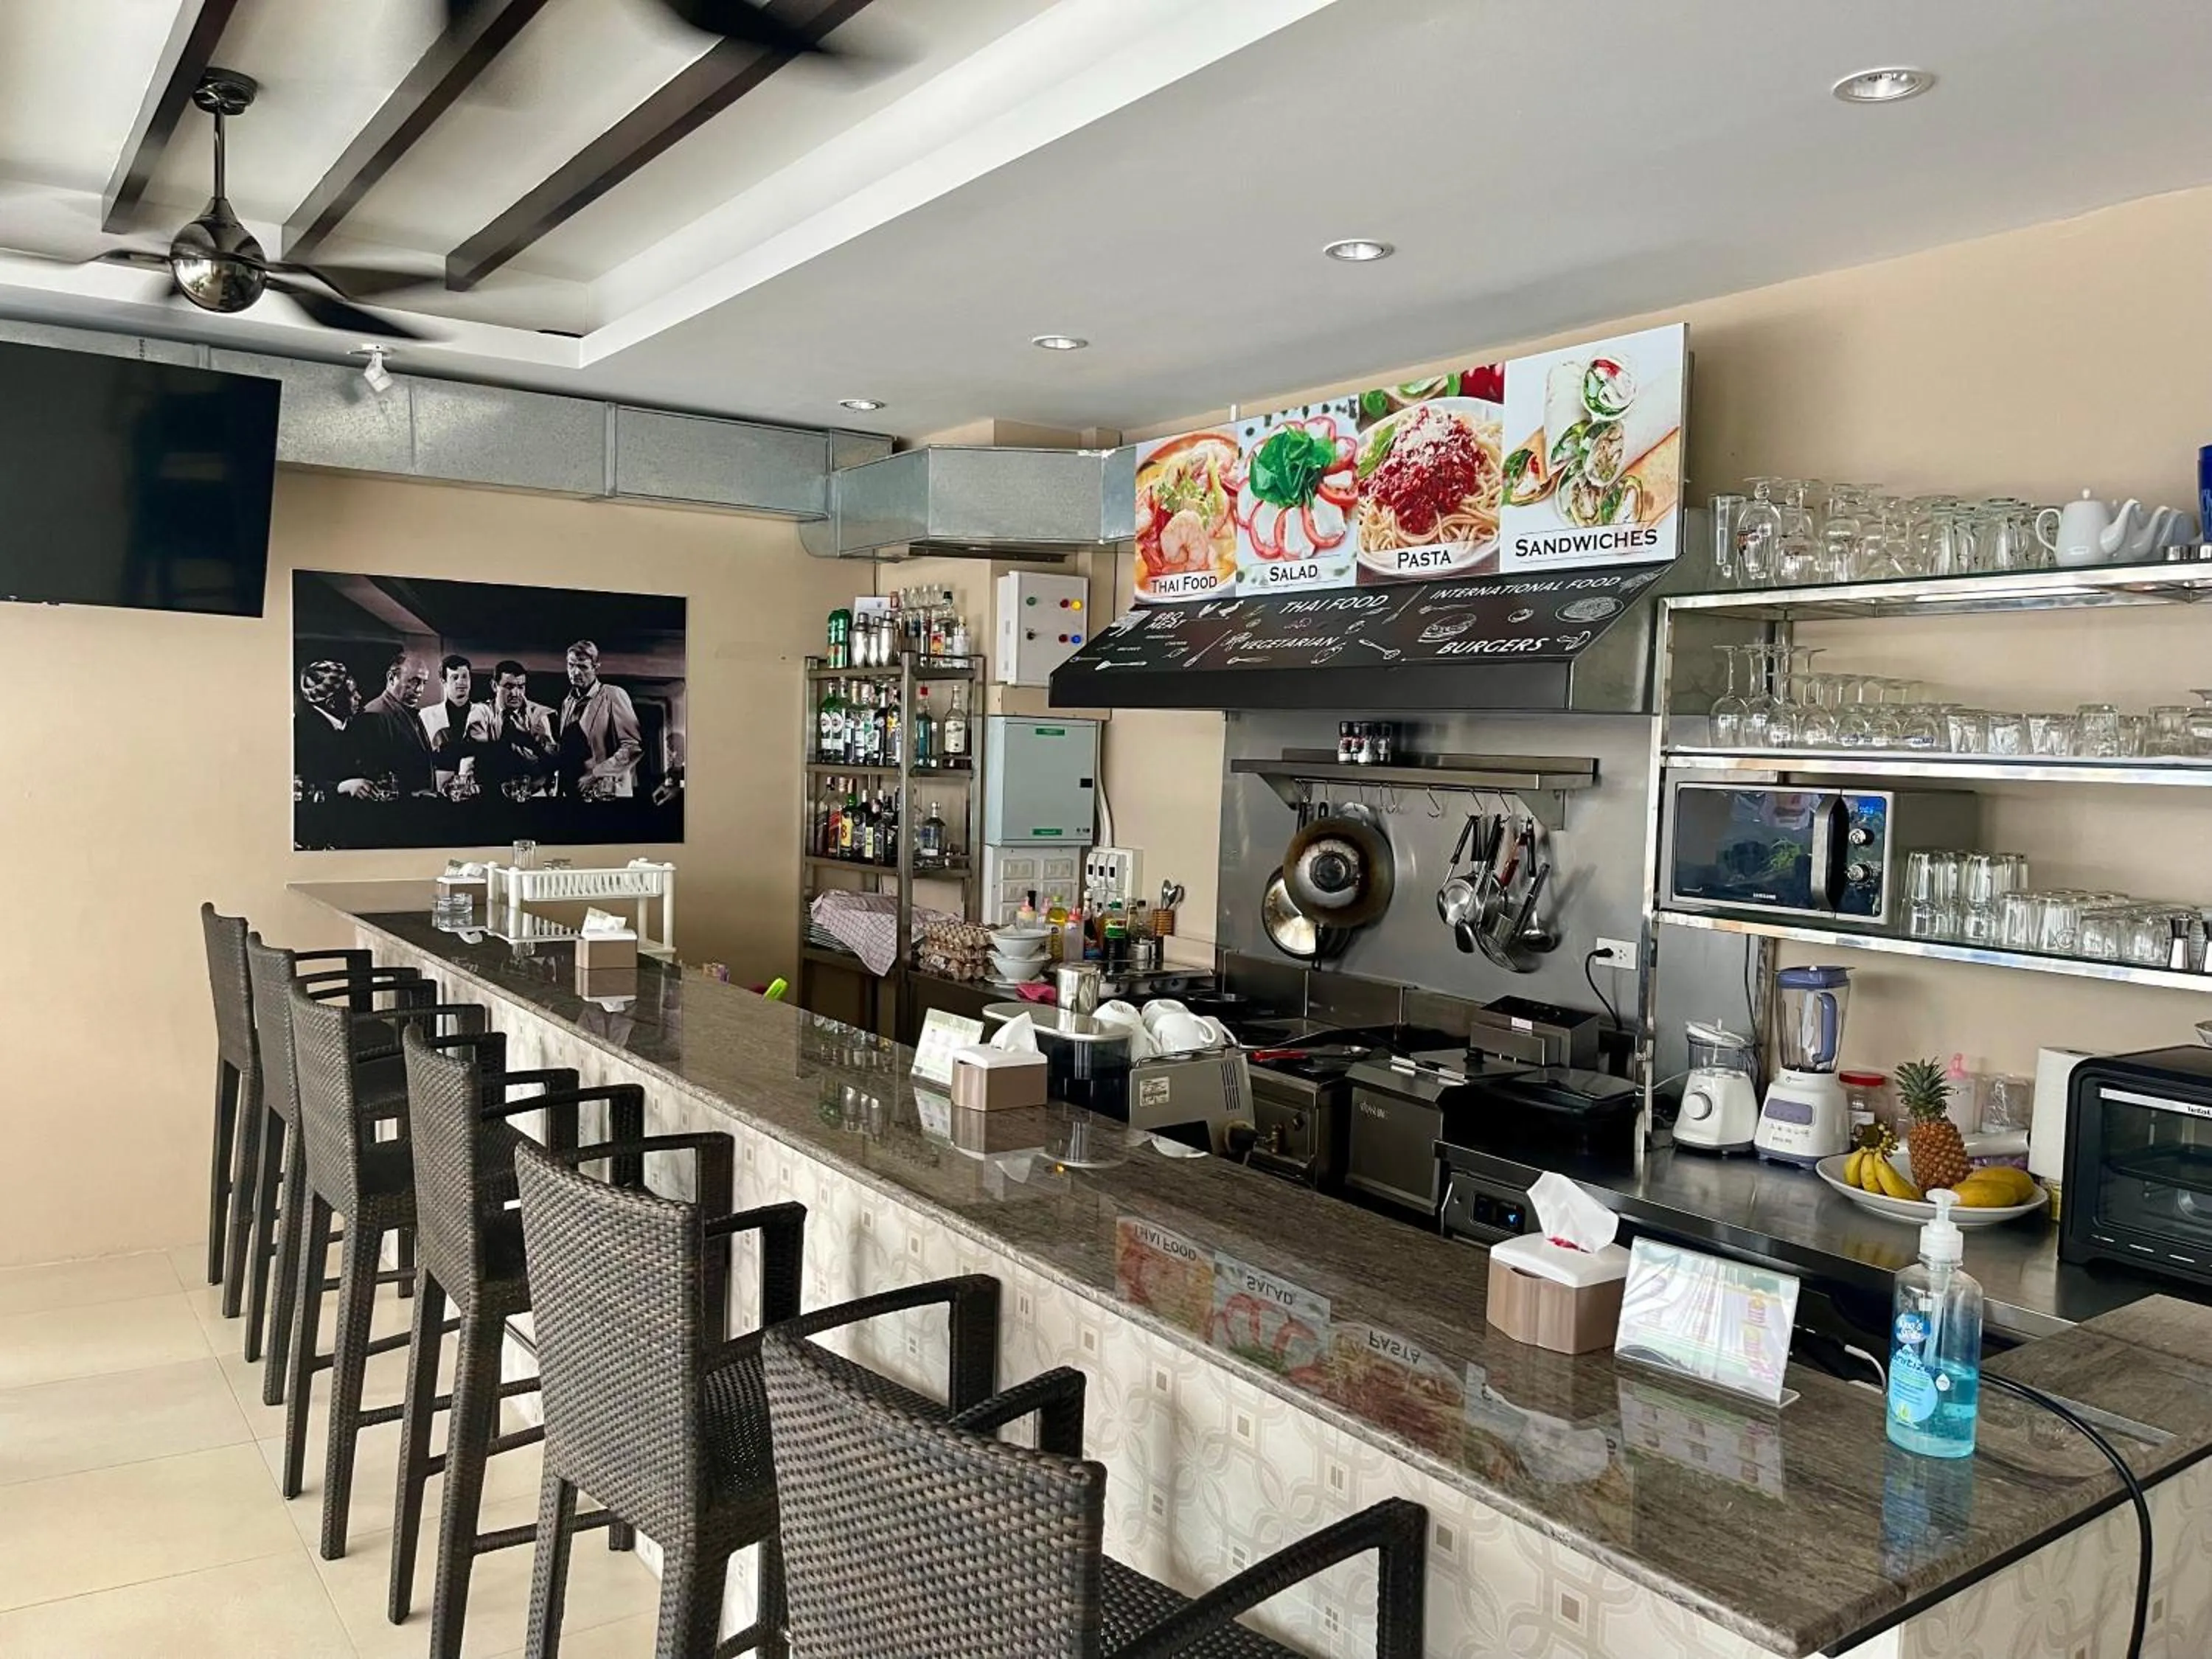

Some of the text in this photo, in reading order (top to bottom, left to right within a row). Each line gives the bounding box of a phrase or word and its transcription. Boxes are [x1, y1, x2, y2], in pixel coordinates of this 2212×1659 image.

[1515, 529, 1658, 557] SANDWICHES
[1397, 550, 1452, 568] PASTA
[1269, 565, 1318, 582] SALAD
[1152, 576, 1217, 593] THAI FOOD
[1430, 576, 1622, 599] INTERNATIONAL FOOD
[1279, 595, 1389, 613] THAI FOOD
[1240, 636, 1340, 650] VEGETARIAN
[1436, 637, 1551, 655] BURGERS
